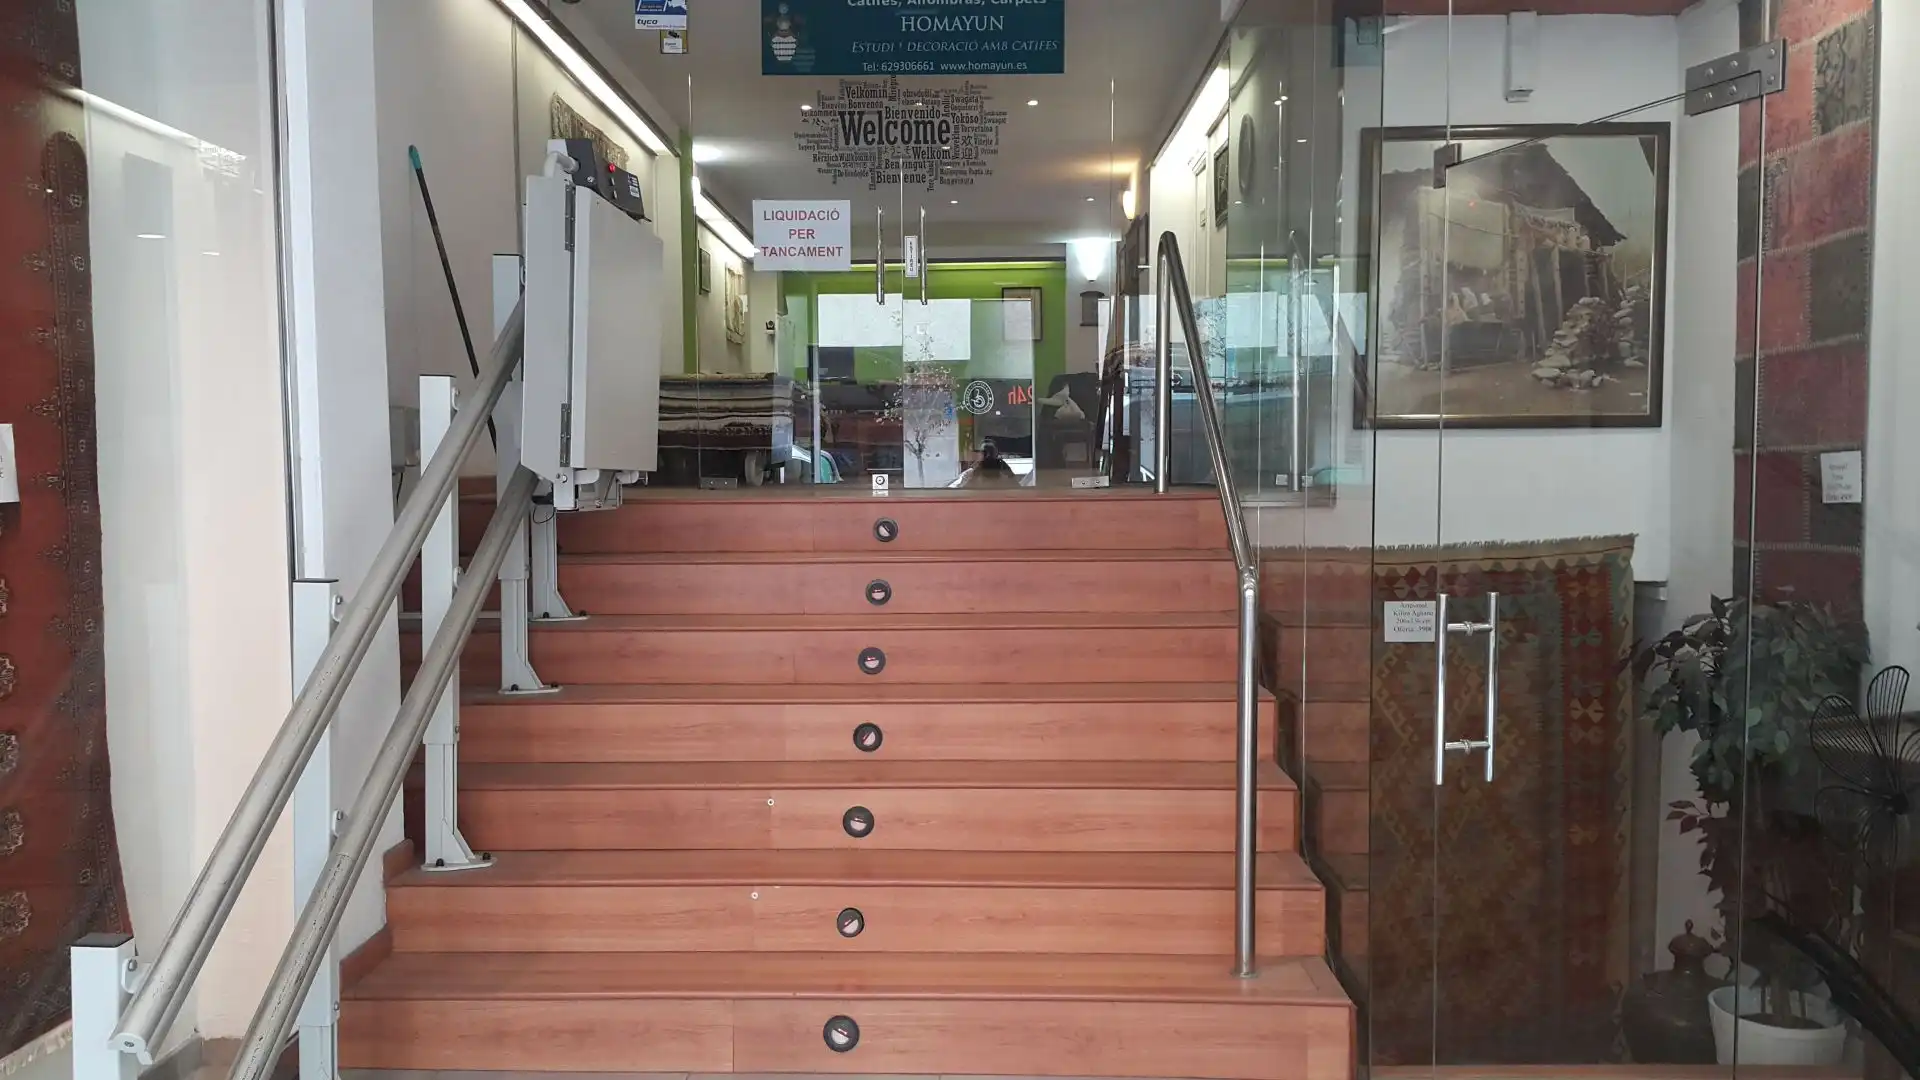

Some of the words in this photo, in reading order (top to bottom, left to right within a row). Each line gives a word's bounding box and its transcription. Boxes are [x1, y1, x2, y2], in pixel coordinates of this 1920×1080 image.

[637, 18, 663, 26] tyco
[900, 15, 1004, 32] HOMAYUN
[852, 40, 895, 52] ESTUDI
[980, 40, 1008, 52] AMB
[1012, 39, 1059, 51] CATIFES
[863, 61, 879, 72] Tel:
[881, 60, 935, 72] 629306661
[940, 59, 1028, 73] www.homayun.es
[846, 85, 888, 99] Velkomin
[885, 105, 941, 120] Bienvenido
[838, 109, 951, 146] Welcome
[912, 146, 951, 160] Welkom
[763, 208, 841, 222] LIQUIDACIÓ
[788, 228, 816, 240] PER
[760, 246, 844, 257] TANCAMENT
